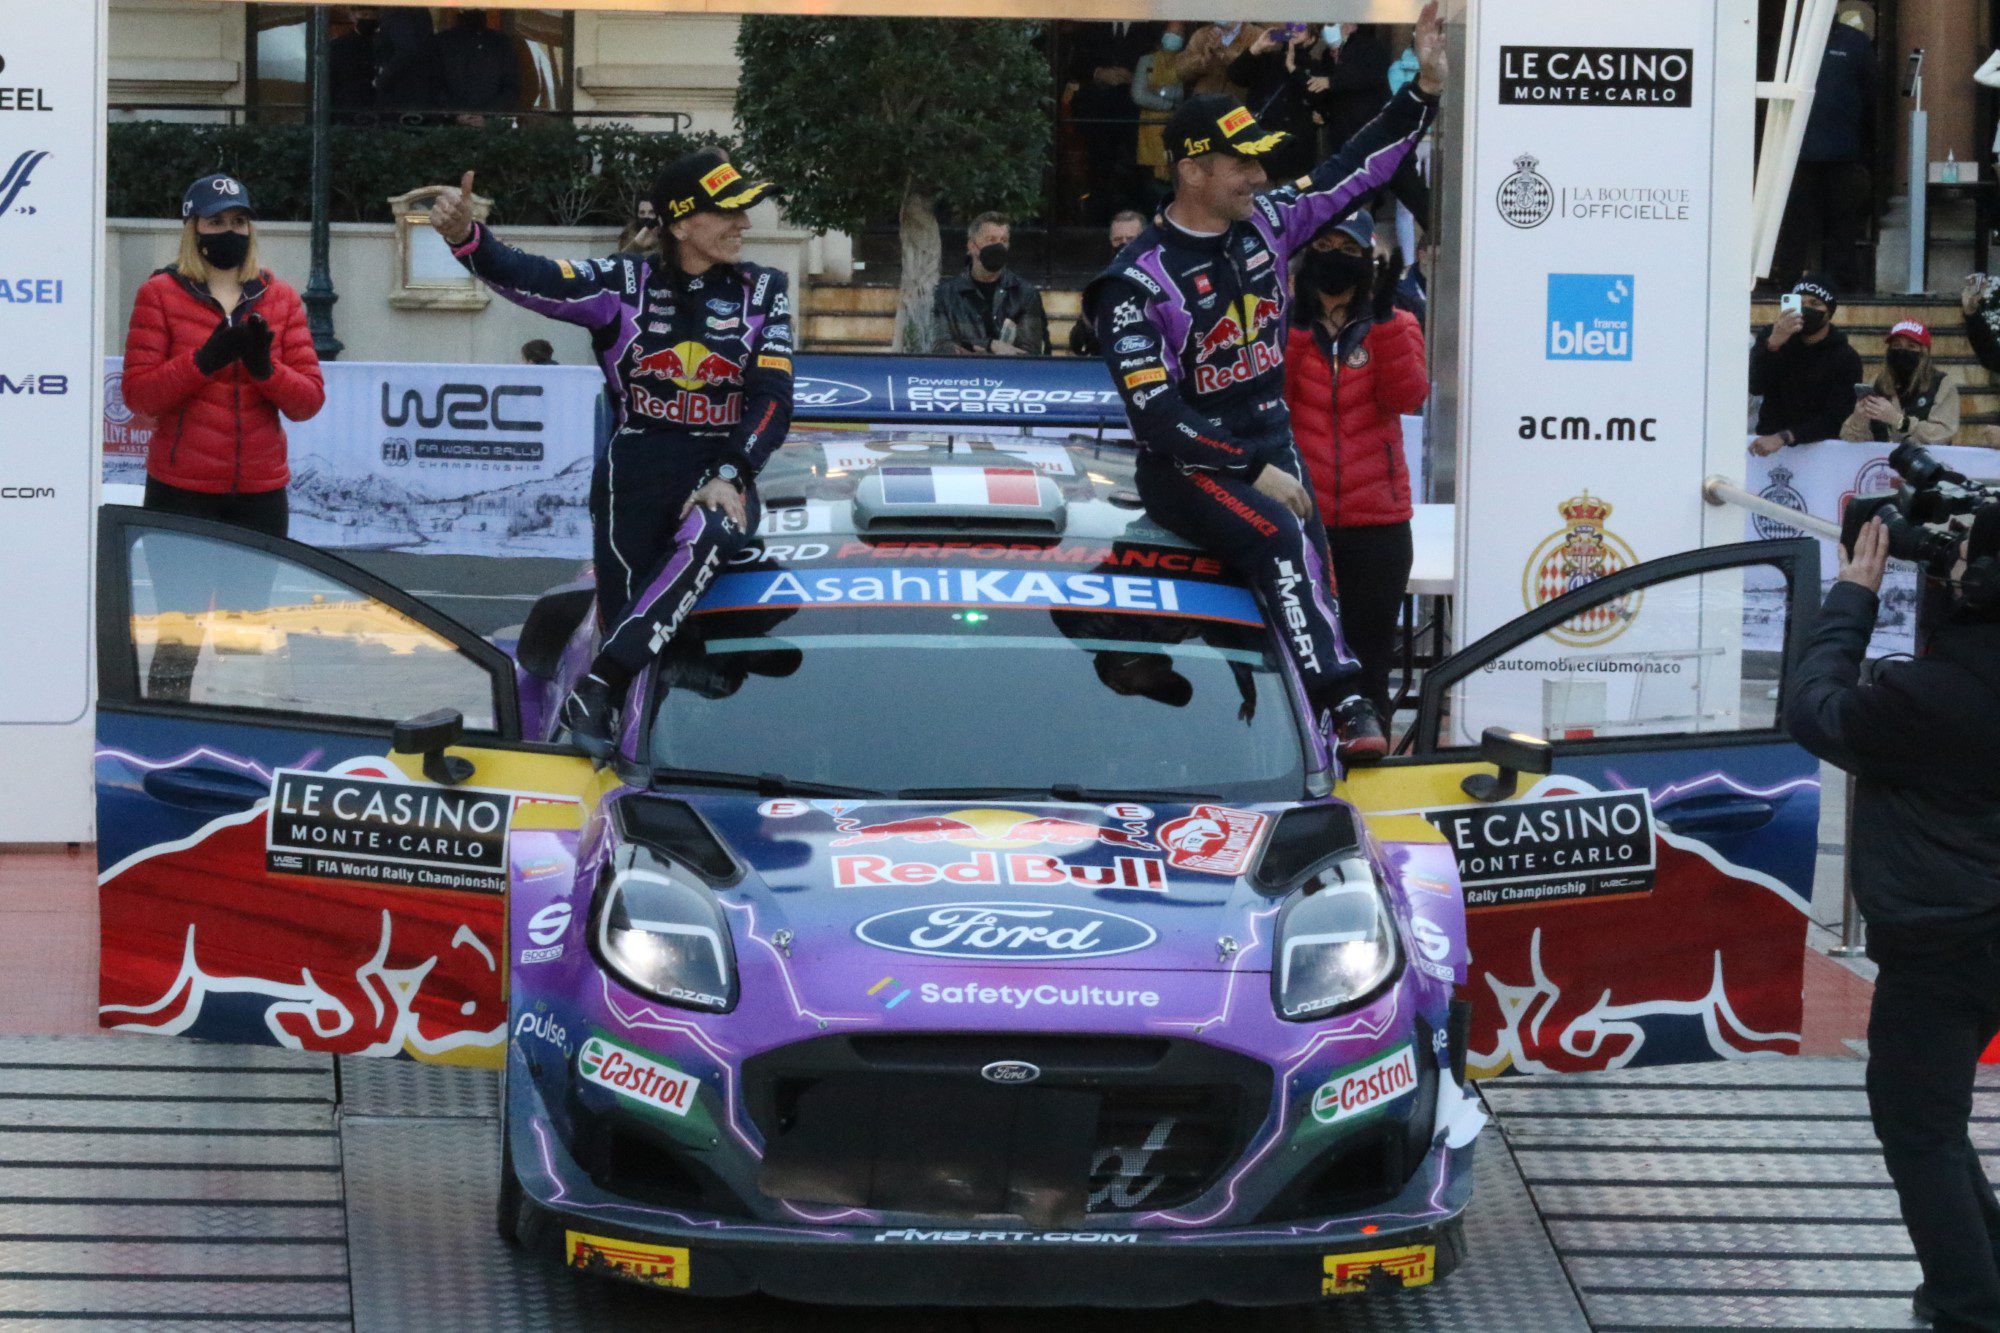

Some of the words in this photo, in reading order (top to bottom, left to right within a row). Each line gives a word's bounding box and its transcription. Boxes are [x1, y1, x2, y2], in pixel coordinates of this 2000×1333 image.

[1505, 52, 1539, 79] LE
[1547, 53, 1688, 82] CASINO
[1184, 137, 1212, 156] 1ST
[669, 195, 695, 219] 1ST
[1572, 187, 1595, 201] LA
[1599, 188, 1690, 205] BOUTIQUE
[1572, 203, 1690, 220] OFFICIELLE
[751, 273, 771, 306] sparco
[1123, 266, 1161, 295] sparco
[1593, 317, 1628, 330] france
[1551, 321, 1628, 356] bleu
[1195, 347, 1253, 394] Red
[1251, 341, 1284, 375] Bu
[907, 387, 1118, 402] ECOBOOST
[908, 376, 979, 387] Powered
[984, 377, 1003, 389] by
[382, 381, 544, 431] WRC
[630, 383, 688, 423] Red
[688, 390, 744, 425] Bull
[909, 402, 1047, 413] HYBRID
[1518, 415, 1657, 442] acm.mc
[383, 443, 408, 461] FIA
[418, 444, 439, 452] FIA
[442, 446, 491, 456] WORLD
[494, 447, 541, 457] RALLY
[418, 461, 541, 471] CHAMPIONSHIP
[767, 508, 809, 532] 19
[727, 543, 829, 565] ORD
[836, 541, 1222, 574] PERFORMANCE
[281, 782, 323, 816] LE
[333, 788, 499, 833] CASINO
[770, 804, 795, 816] E
[1119, 805, 1140, 818] E
[1484, 803, 1642, 848] CASINO
[316, 860, 339, 873] FIA
[342, 862, 378, 878] World
[382, 867, 414, 883] Rally
[418, 870, 506, 892] Championship
[831, 852, 1001, 888] Red
[1008, 855, 1169, 892] Bull
[1467, 887, 1498, 903] Rally
[1502, 880, 1587, 899] Championship
[910, 906, 1103, 950] Ford
[523, 947, 562, 962] sparco
[920, 982, 1159, 1010] SafetyCulture
[514, 1012, 567, 1047] pulse
[600, 1051, 690, 1109] Castrol
[993, 1063, 1027, 1081] Ford
[1341, 1055, 1414, 1111] Castrol
